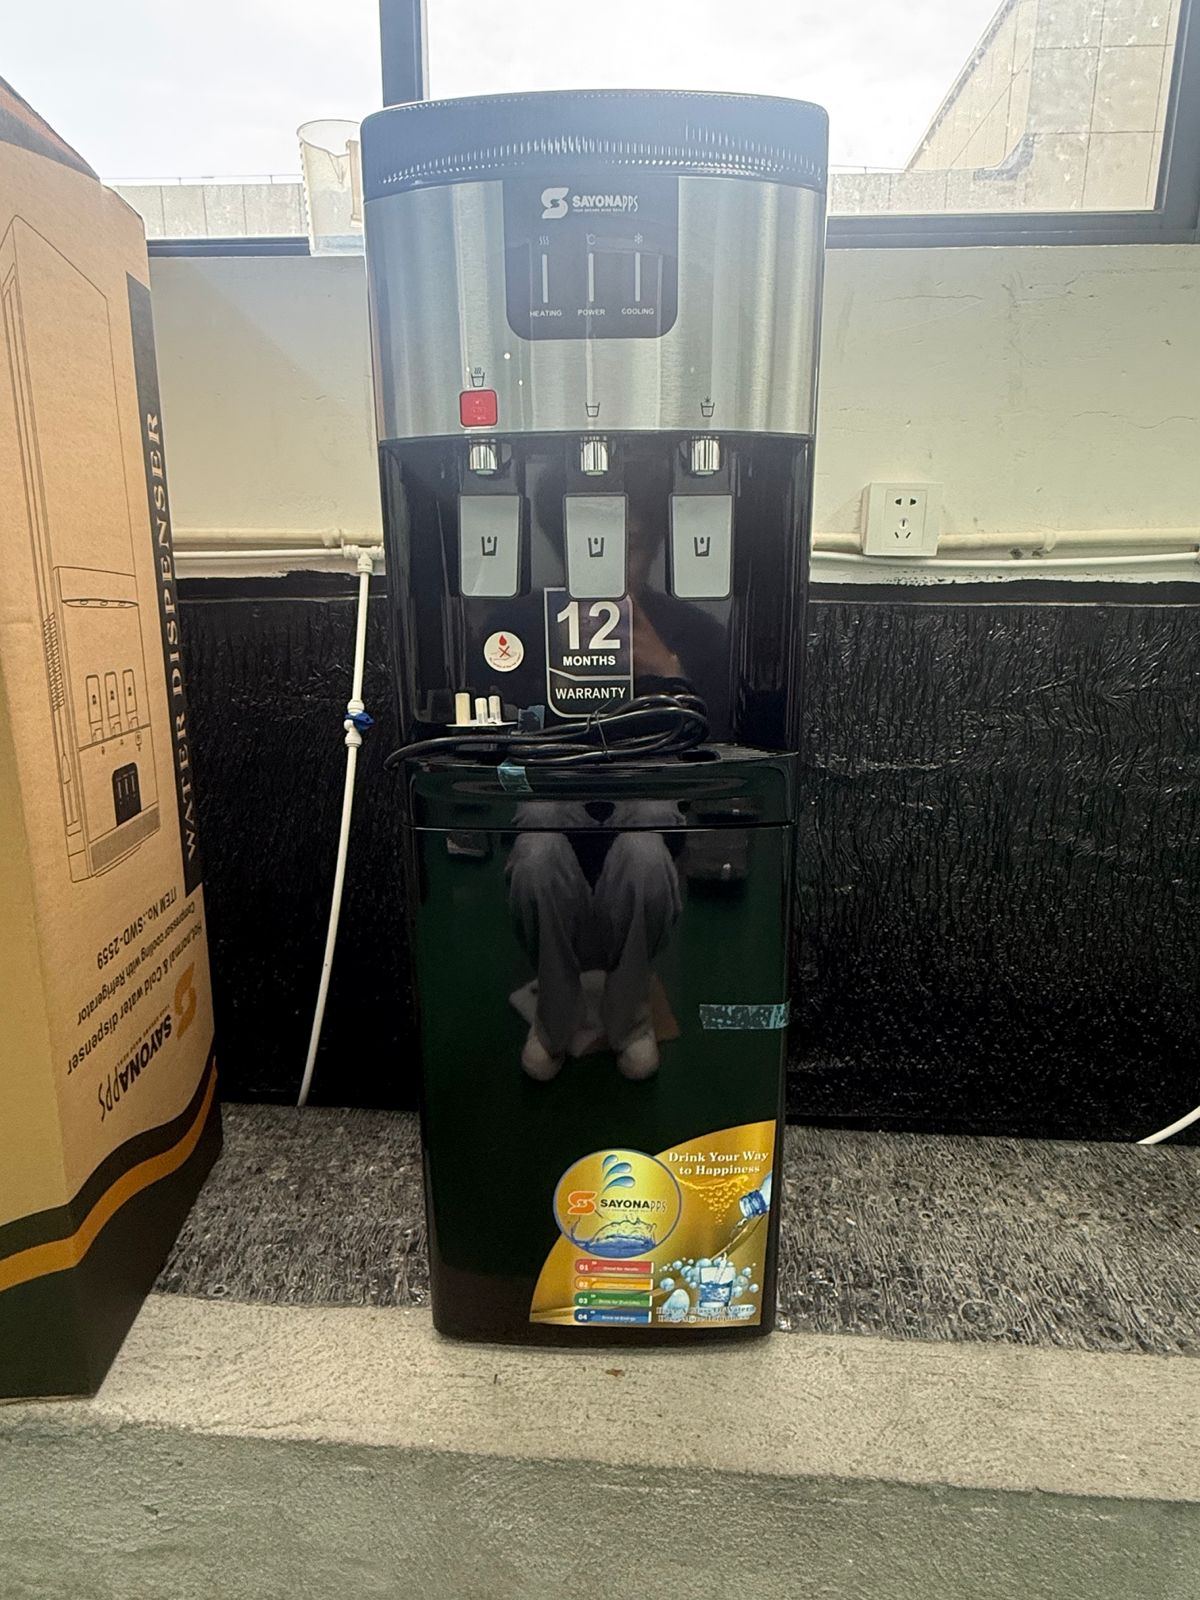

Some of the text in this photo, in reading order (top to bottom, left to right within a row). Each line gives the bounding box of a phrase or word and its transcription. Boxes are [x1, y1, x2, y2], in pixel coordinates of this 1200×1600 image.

[529, 308, 563, 318] HEATING
[577, 308, 606, 317] POWER
[621, 307, 655, 316] COOLING
[146, 412, 196, 862] WATER DISPENSER
[556, 601, 621, 650] 12
[562, 655, 617, 667] MONTHS
[555, 687, 626, 700] WARRANTY
[159, 885, 177, 914] ITEM
[126, 955, 142, 979] with
[143, 966, 164, 990] Cold
[76, 969, 126, 1026] Refrigerator
[119, 985, 144, 1020] water
[67, 1011, 119, 1076] dispenser
[669, 1151, 770, 1162] Drink Your Way
[679, 1163, 761, 1176] to Happiness
